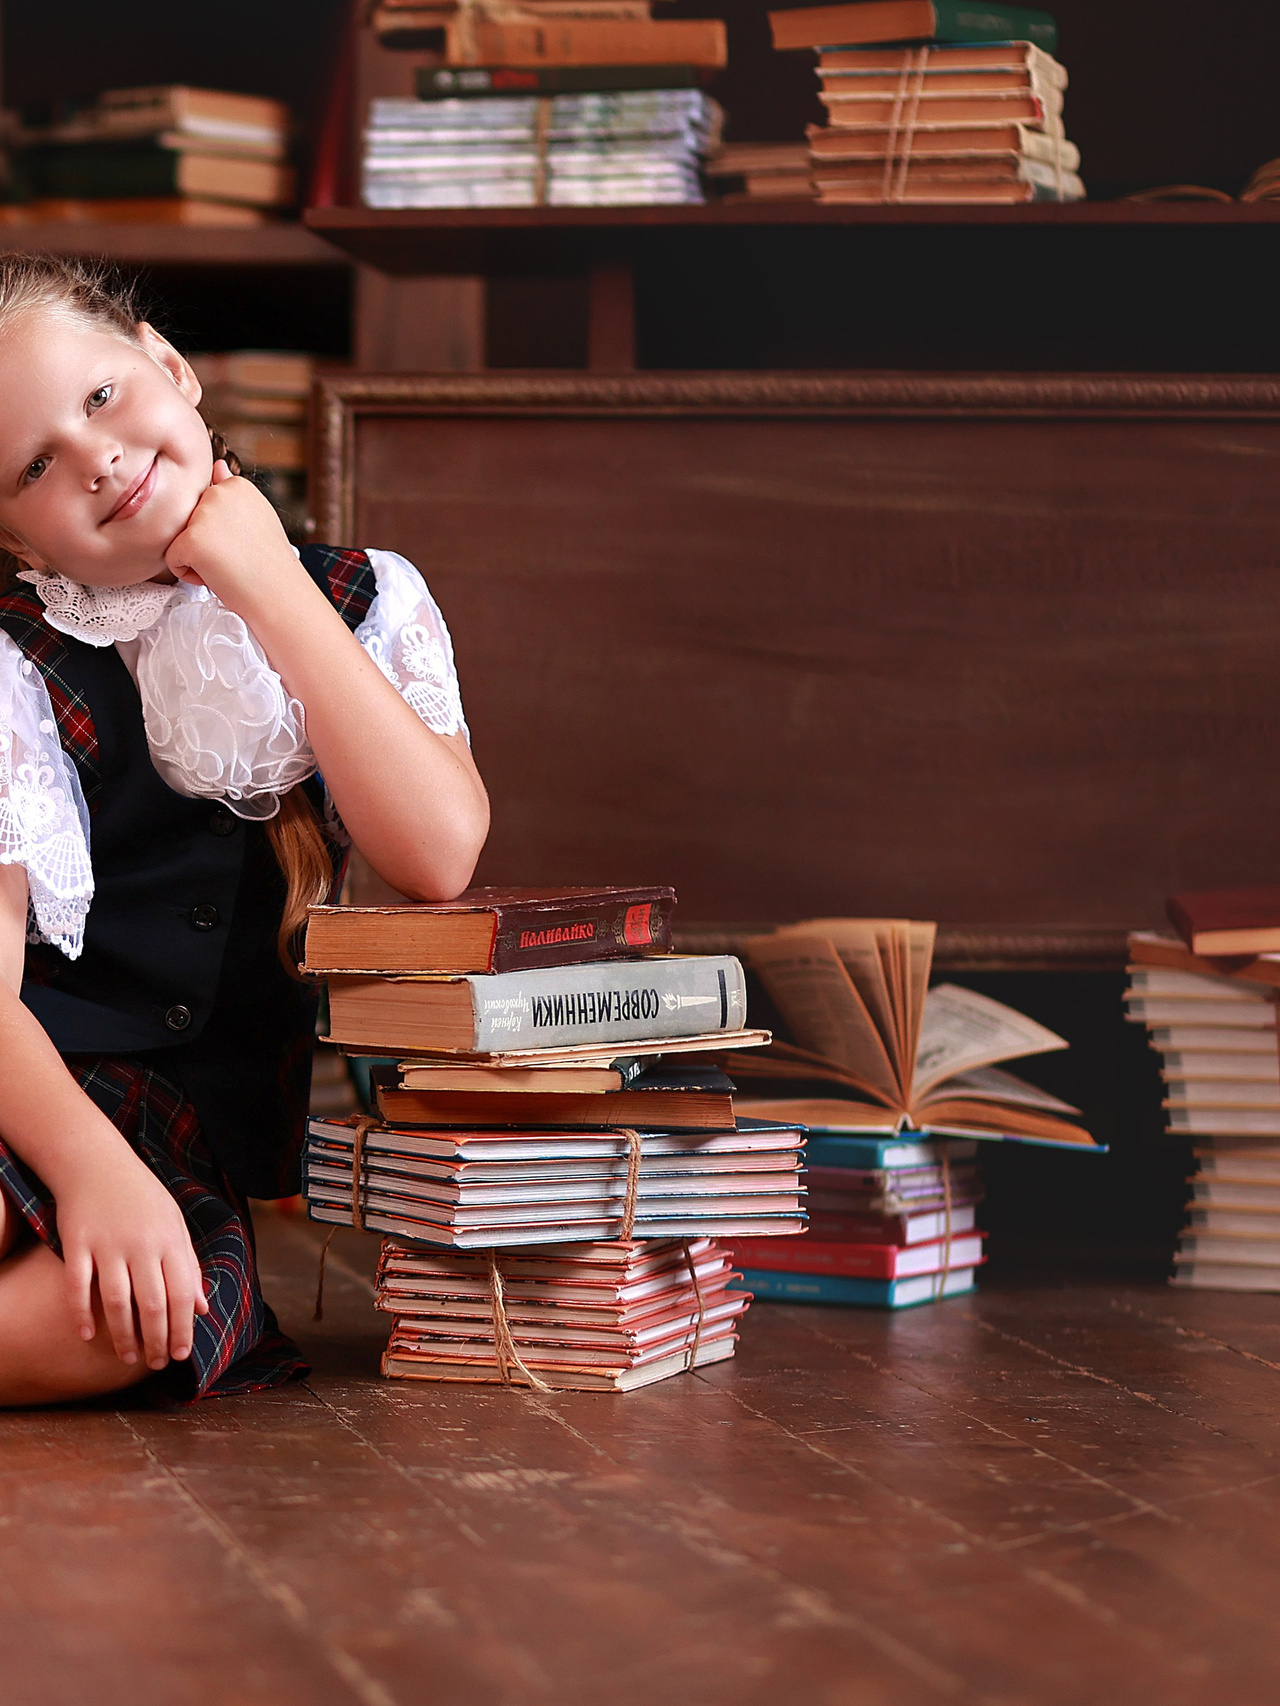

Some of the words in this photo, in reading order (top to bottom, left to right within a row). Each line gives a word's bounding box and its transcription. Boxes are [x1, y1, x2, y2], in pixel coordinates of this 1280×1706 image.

[483, 990, 530, 1015] Чуковский
[531, 988, 660, 1028] СОВРЕМЕННИКИ
[490, 1011, 523, 1034] Корней
